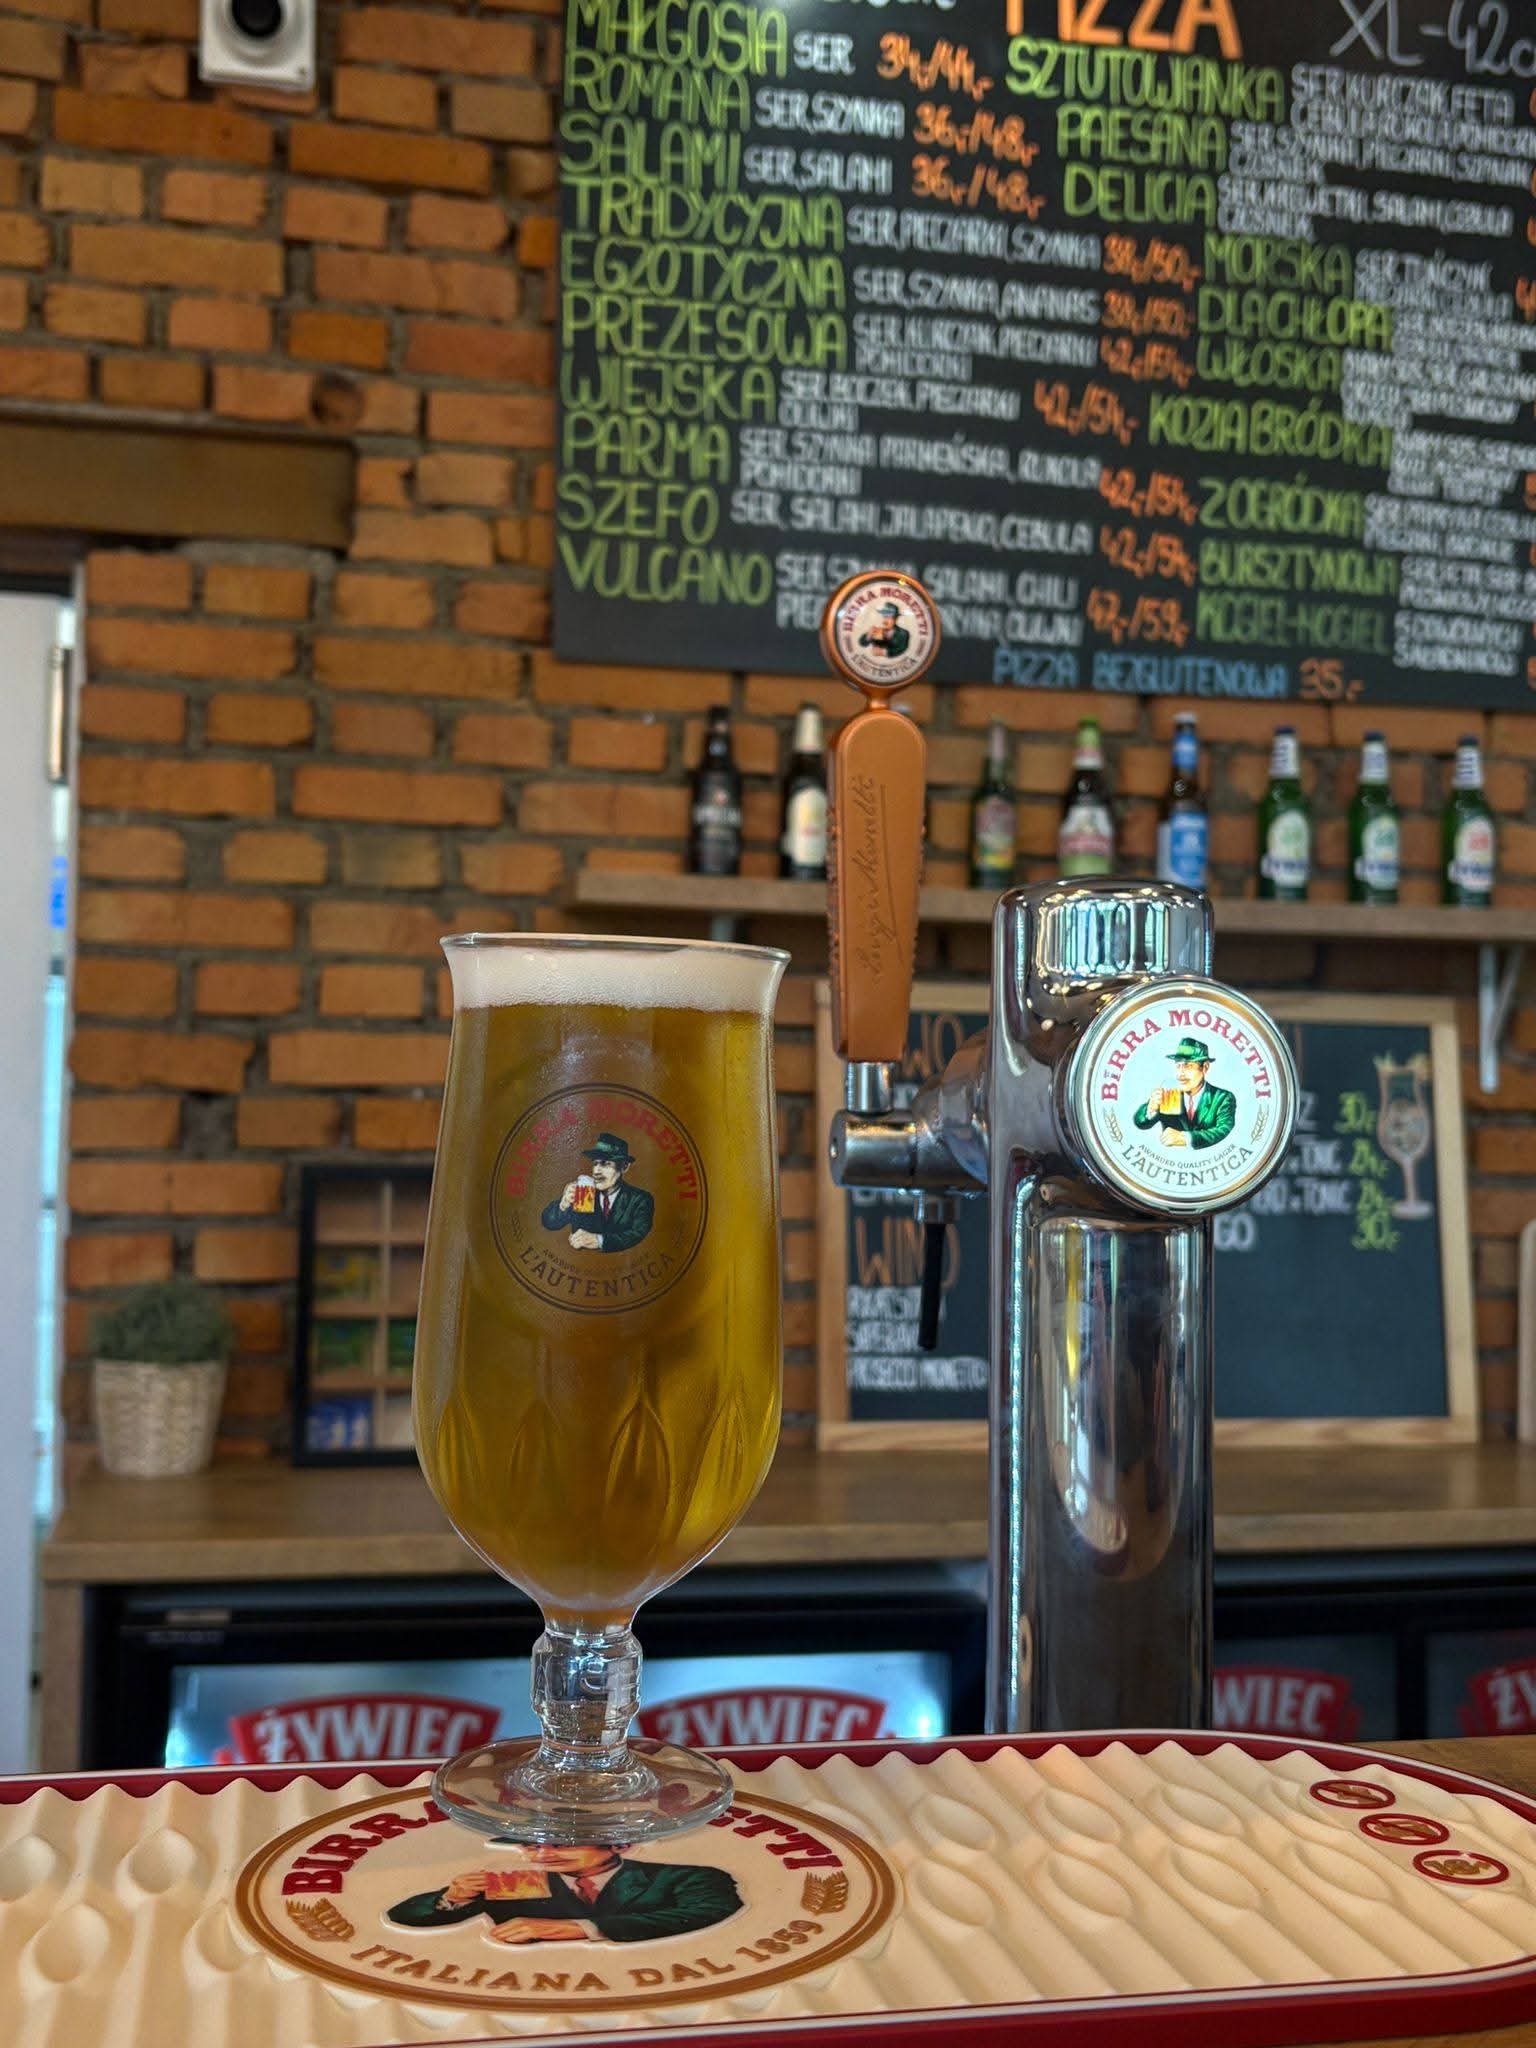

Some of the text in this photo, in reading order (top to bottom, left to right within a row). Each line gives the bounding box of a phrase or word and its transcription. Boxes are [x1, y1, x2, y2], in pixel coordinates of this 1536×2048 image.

[793, 31, 855, 75] SER
[565, 48, 750, 130] ROMANA
[559, 109, 742, 192] SALAMI
[1057, 100, 1227, 171] PAESANA
[560, 174, 844, 250] TRADYCYJNA
[1063, 160, 1217, 227] DELICIA
[560, 231, 846, 309] EGZOTYCZNA
[1204, 232, 1352, 295] MORSKA
[561, 290, 848, 371] PREZESOWA
[1199, 335, 1342, 392] WŁOSKA
[560, 352, 777, 422] WIEJSKA
[562, 410, 732, 484] PARMA
[1149, 390, 1247, 452] KOZIA
[1250, 395, 1394, 470] BRÓDKA
[557, 472, 719, 545] SZEFO
[557, 533, 773, 607] VULCANO
[993, 648, 1079, 687] PIZZA
[1101, 1009, 1271, 1101] BIRRA MORETTI
[507, 1097, 698, 1200] BIRRA MORETTI
[1122, 1144, 1254, 1186] L'AUTENTICA
[1138, 1143, 1237, 1169] AWARDED QUALITY LAGER
[519, 1246, 676, 1298] L'AUTENTICA
[254, 1706, 482, 1760] ŻYWIEC
[657, 1698, 866, 1744] ŻYWIEC
[1213, 1674, 1334, 1734] WIEC
[350, 1919, 823, 1992] ITALIANA DAL 1859
